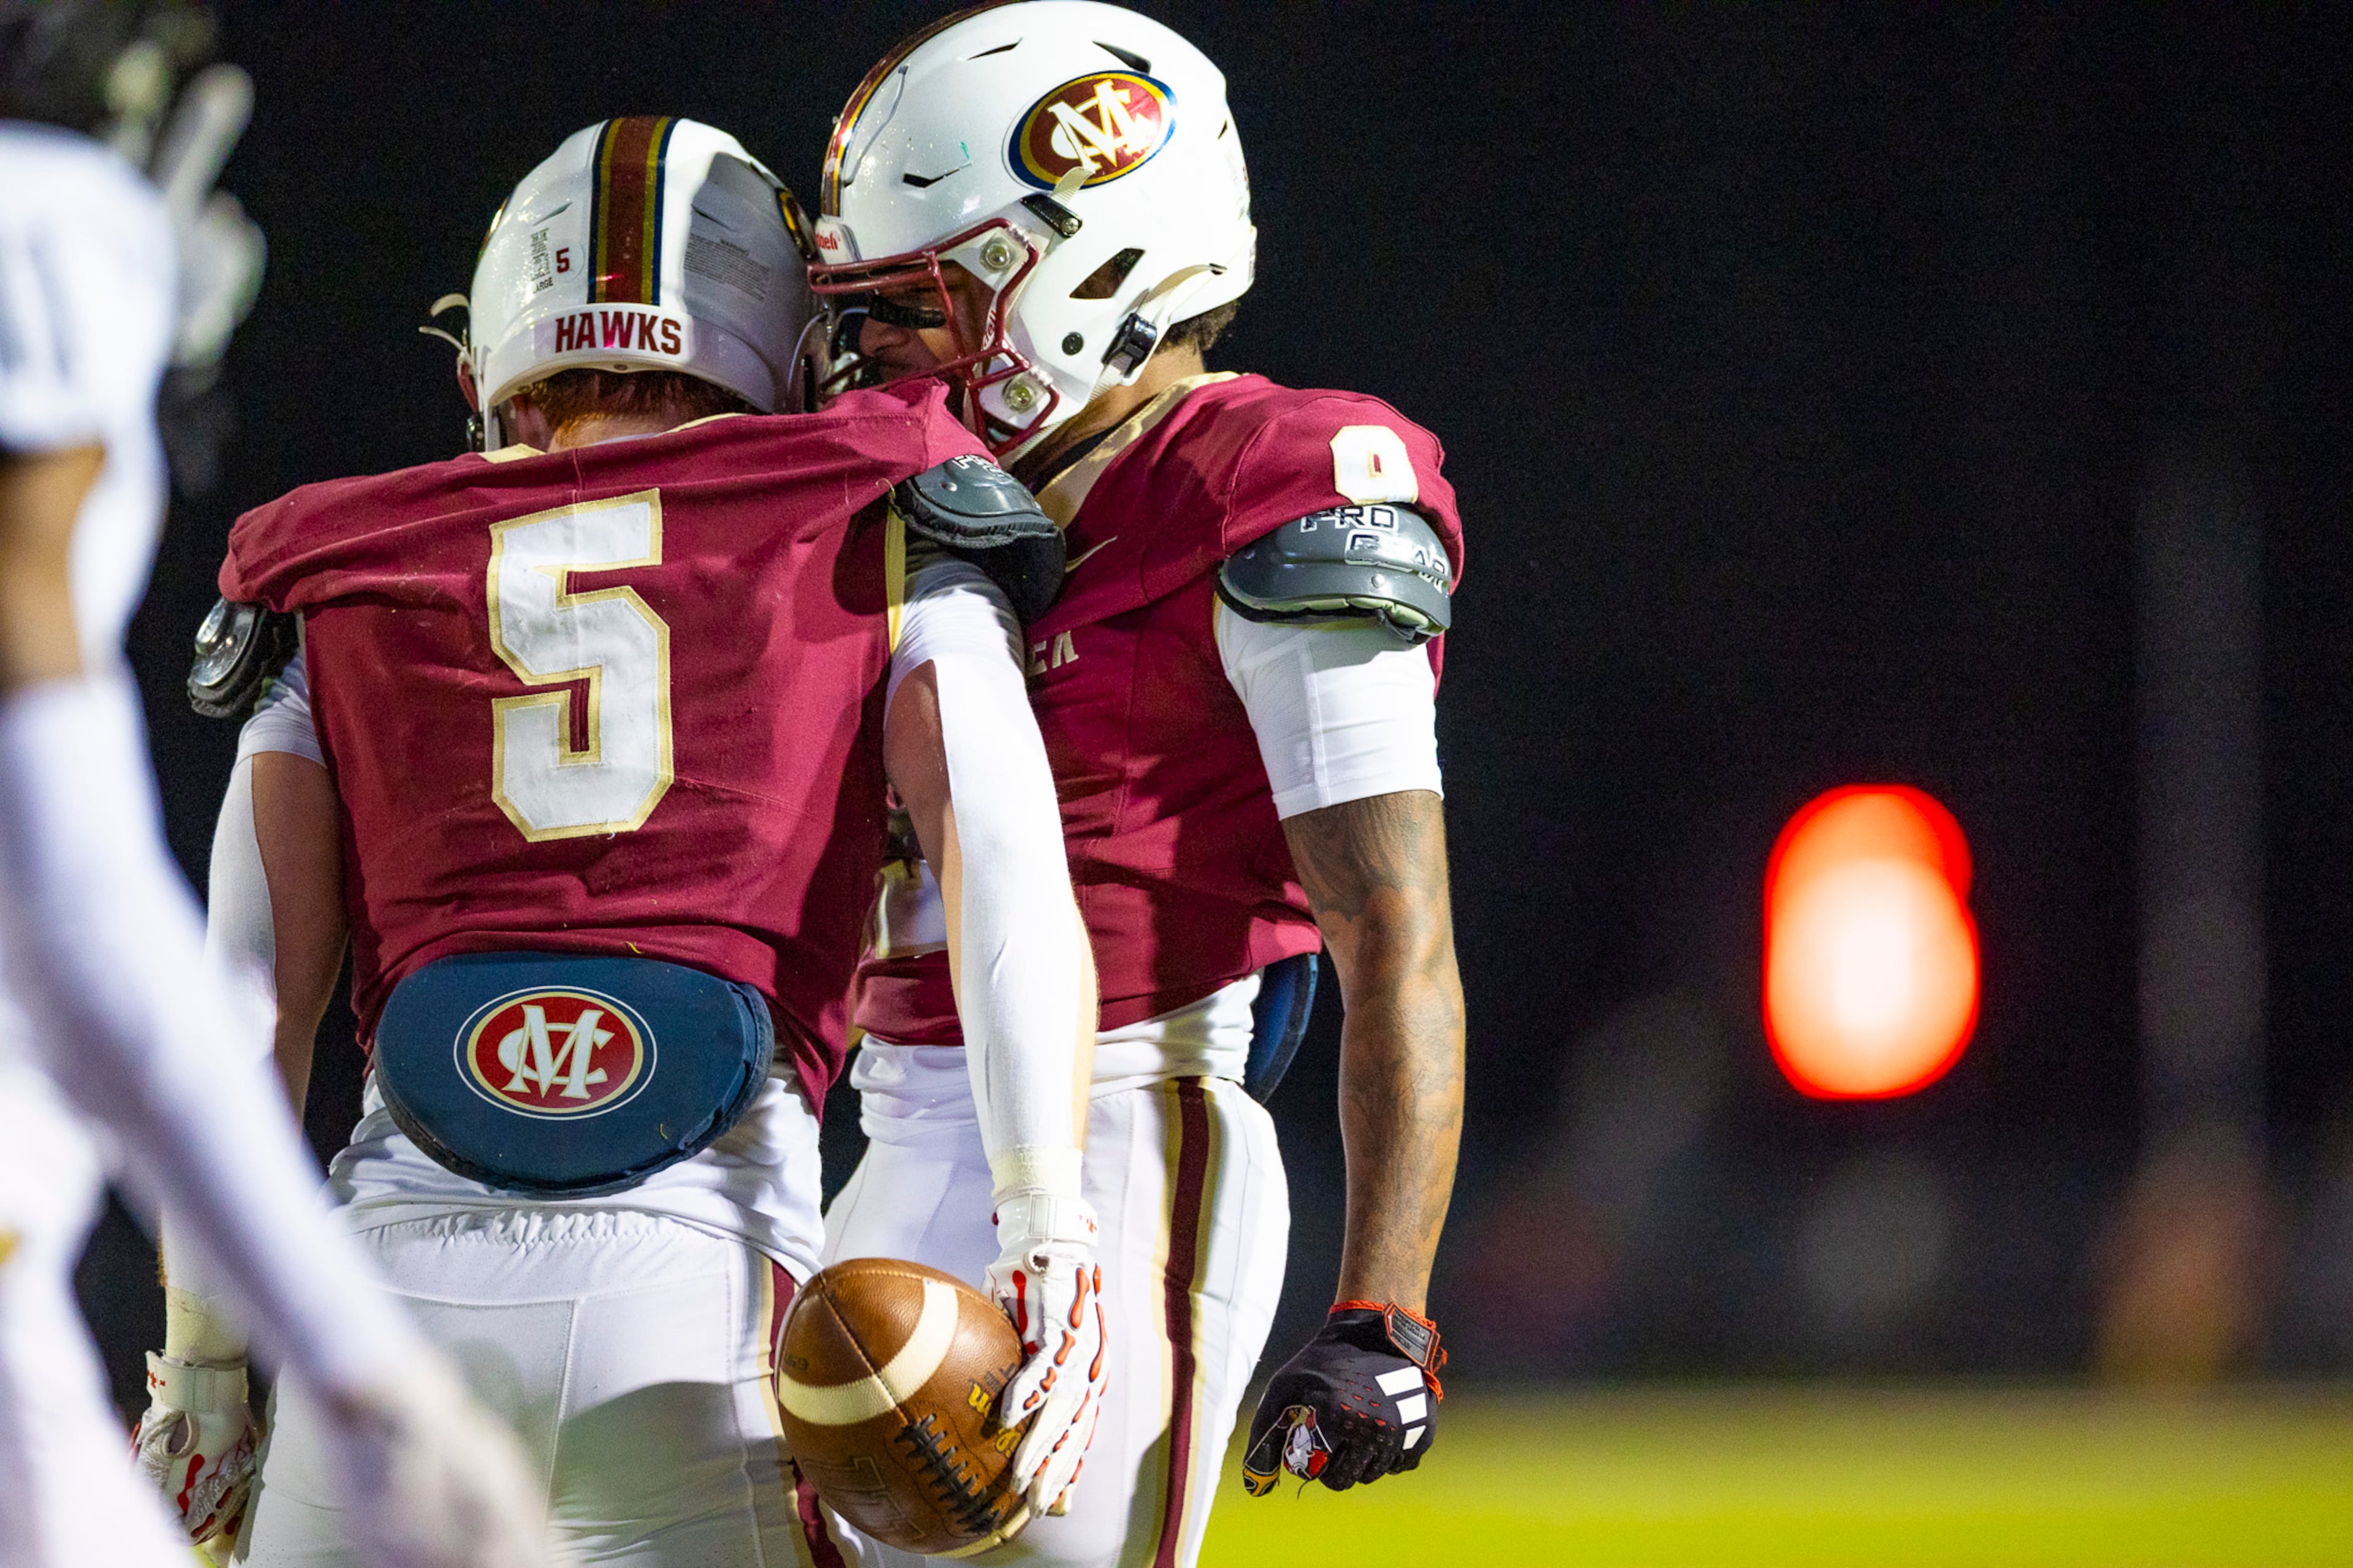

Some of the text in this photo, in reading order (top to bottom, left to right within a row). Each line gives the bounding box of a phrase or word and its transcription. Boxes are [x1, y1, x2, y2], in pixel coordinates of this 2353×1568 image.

[555, 247, 570, 274] 5
[555, 311, 681, 355] HAWKS
[487, 488, 673, 842] 5
